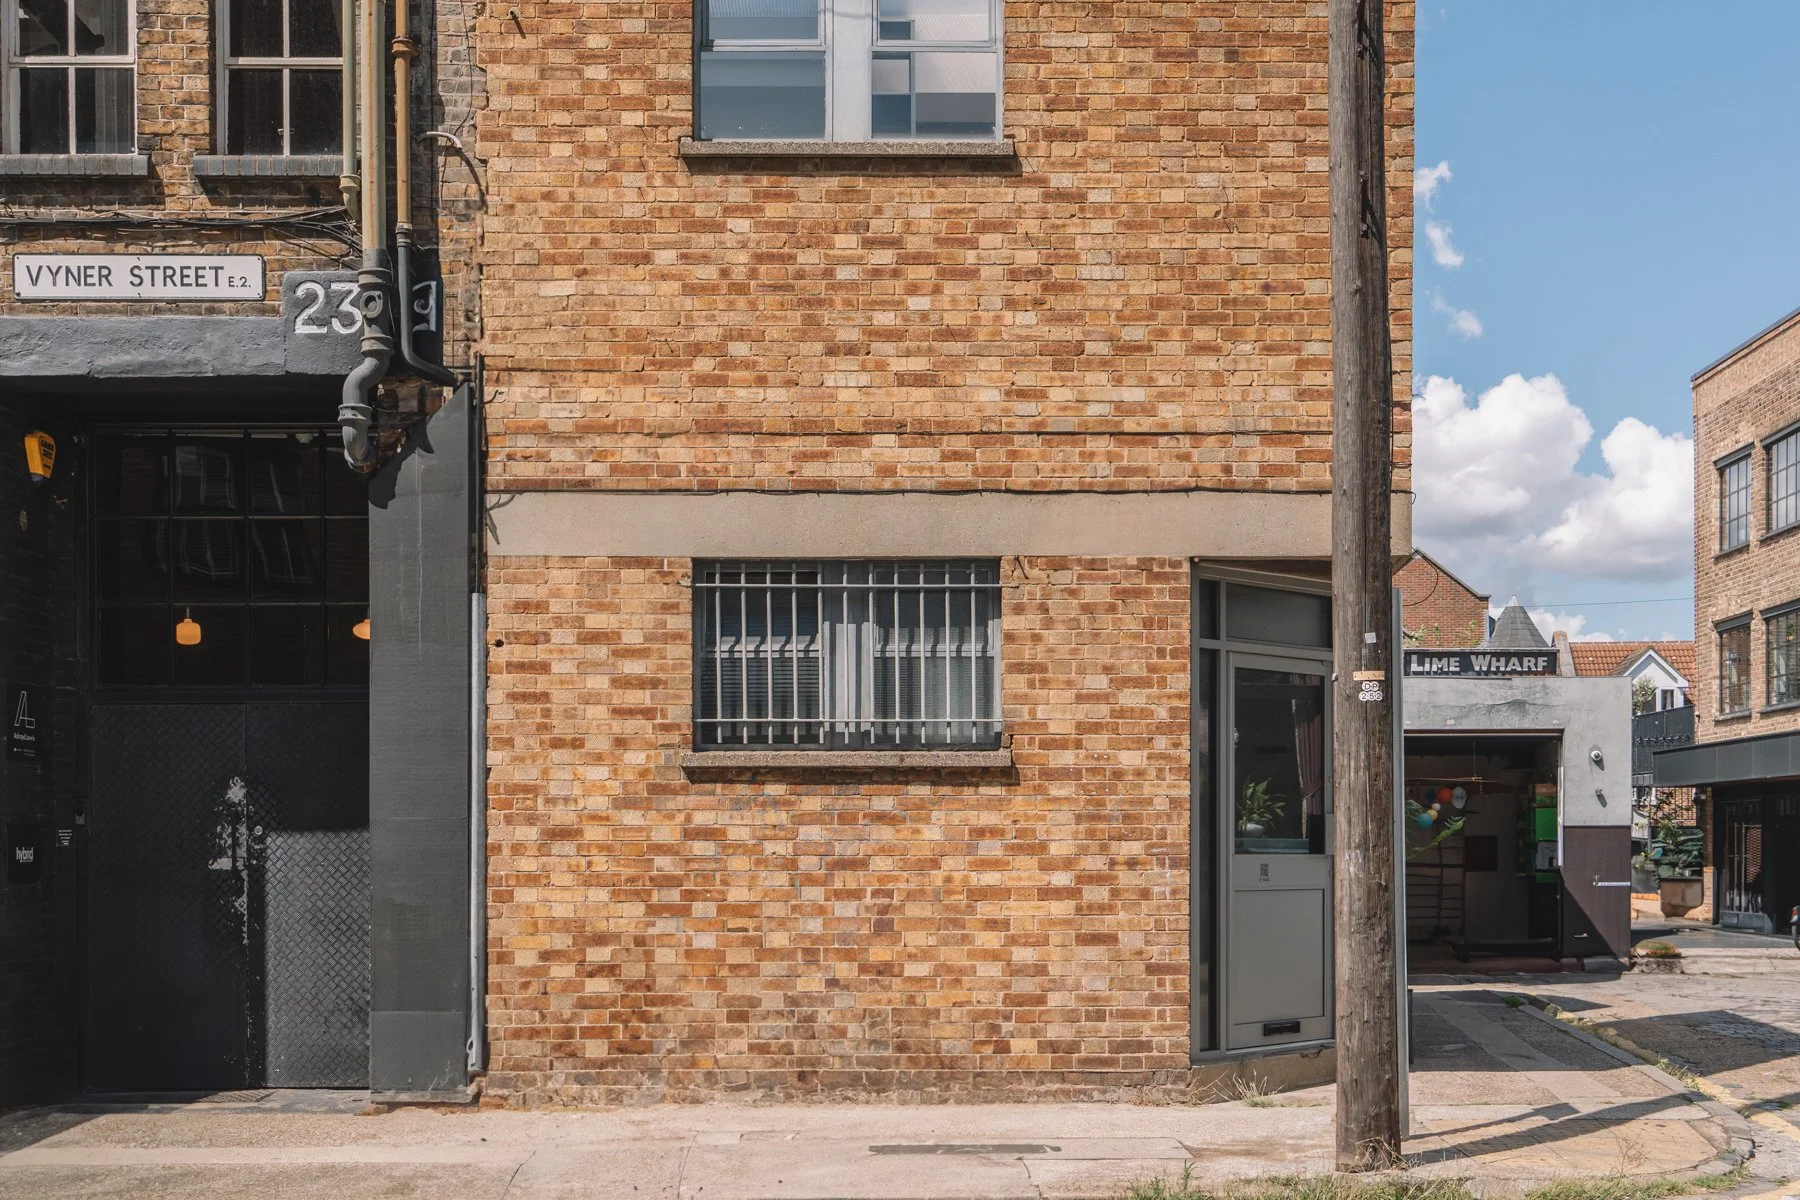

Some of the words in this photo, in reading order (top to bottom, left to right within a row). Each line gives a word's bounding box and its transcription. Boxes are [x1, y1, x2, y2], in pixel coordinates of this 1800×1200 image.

[26, 265, 113, 287] VYNER
[129, 265, 225, 287] STREET
[294, 280, 363, 334] 23
[1410, 654, 1460, 672] LIME
[1470, 654, 1548, 672] WHARF
[1360, 692, 1382, 700] 252
[16, 847, 33, 863] hybrid
